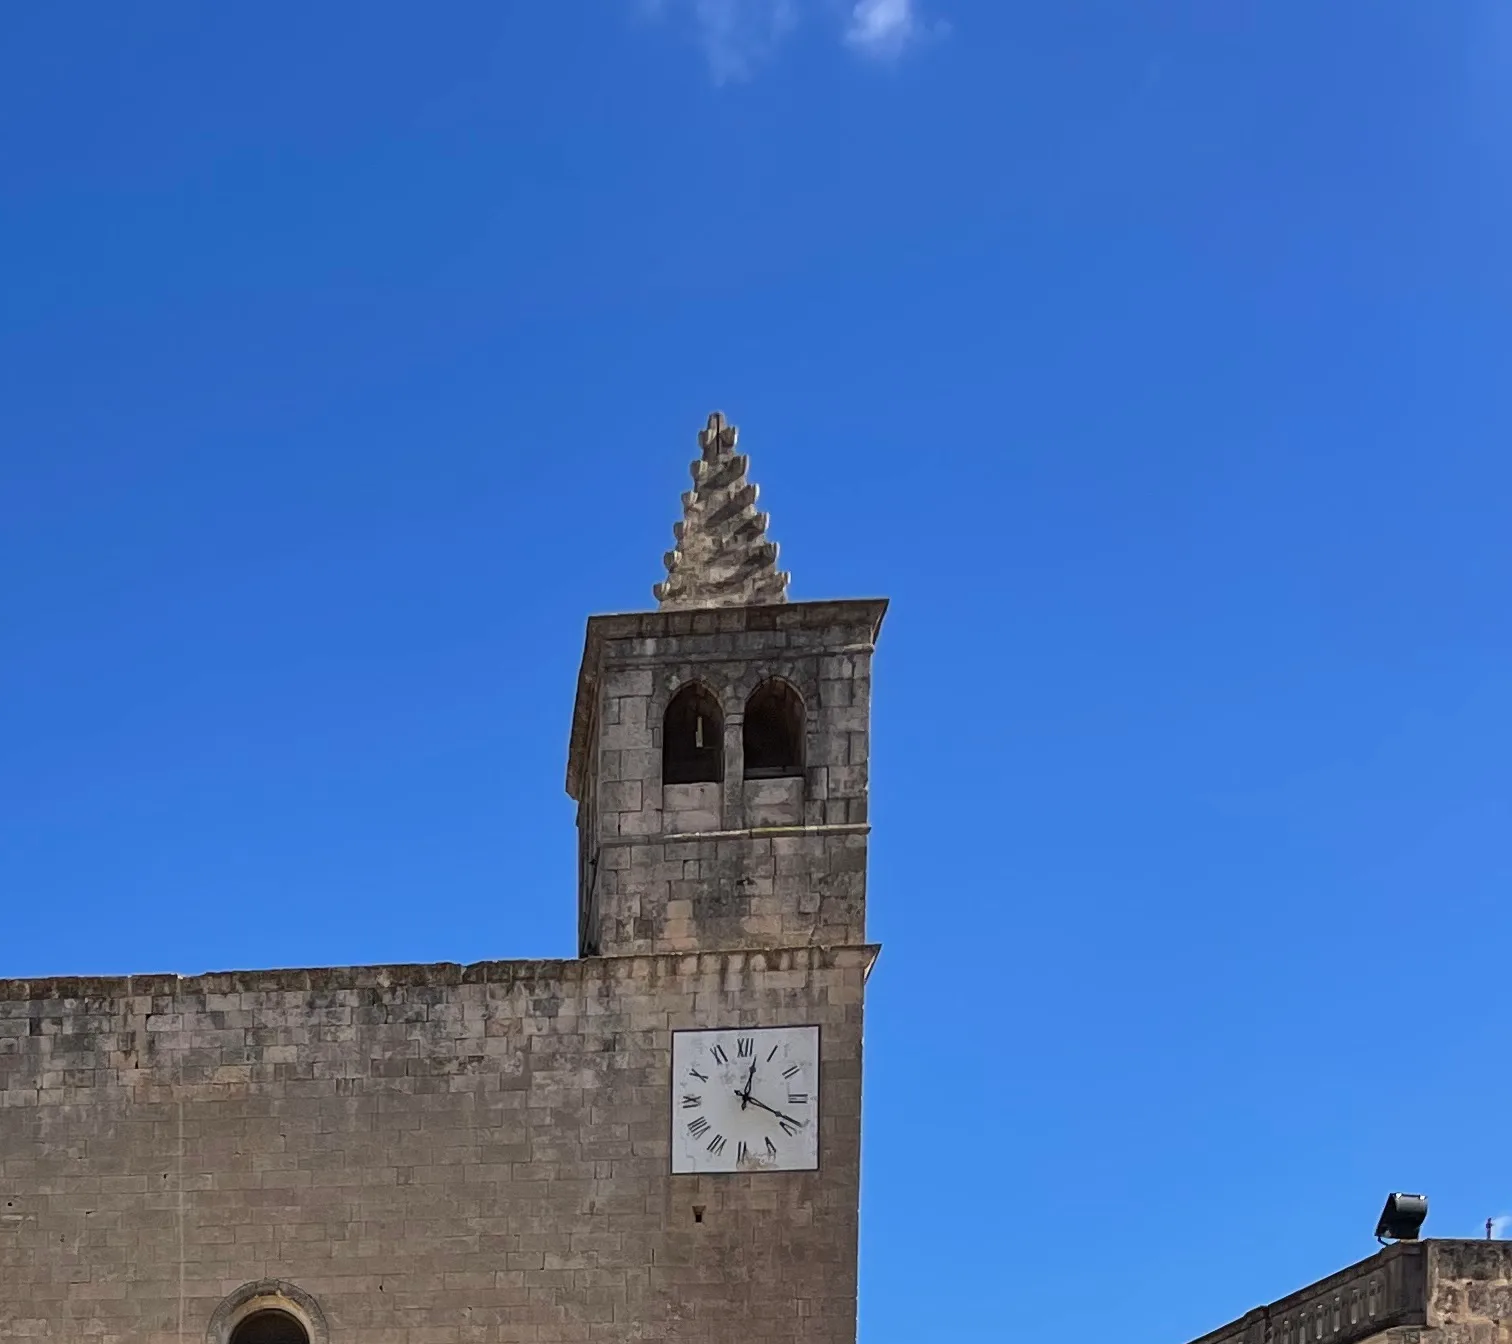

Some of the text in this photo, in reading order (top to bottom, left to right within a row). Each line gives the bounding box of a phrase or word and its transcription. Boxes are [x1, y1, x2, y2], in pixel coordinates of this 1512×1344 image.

[710, 1045, 728, 1065] XI
[737, 1038, 753, 1057] XII
[766, 1045, 778, 1062] I
[689, 1068, 709, 1083] X
[782, 1065, 800, 1079] II
[682, 1095, 702, 1109] IX
[687, 1116, 711, 1140] VIII
[706, 1134, 727, 1157] VII
